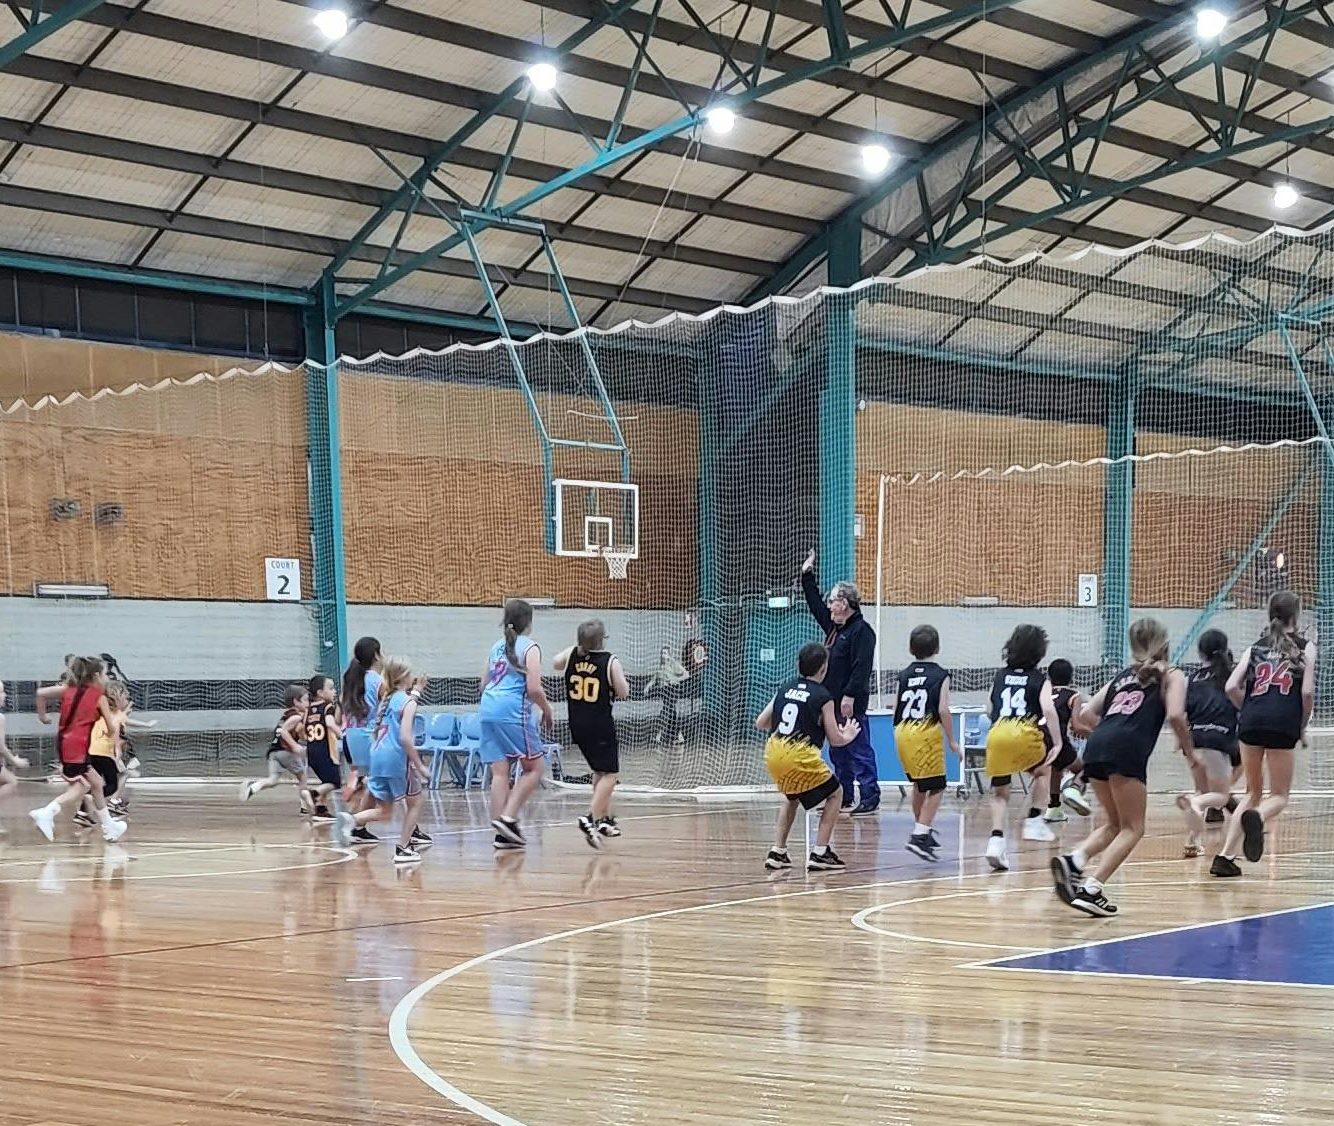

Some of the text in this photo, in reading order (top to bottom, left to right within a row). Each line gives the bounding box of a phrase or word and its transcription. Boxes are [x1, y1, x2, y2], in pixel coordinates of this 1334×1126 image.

[277, 575, 290, 594] 2
[1084, 586, 1091, 602] 3
[569, 674, 600, 702] 30
[1250, 660, 1293, 697] 24
[999, 686, 1027, 717] 14
[307, 723, 325, 742] 30
[778, 702, 799, 735] 9
